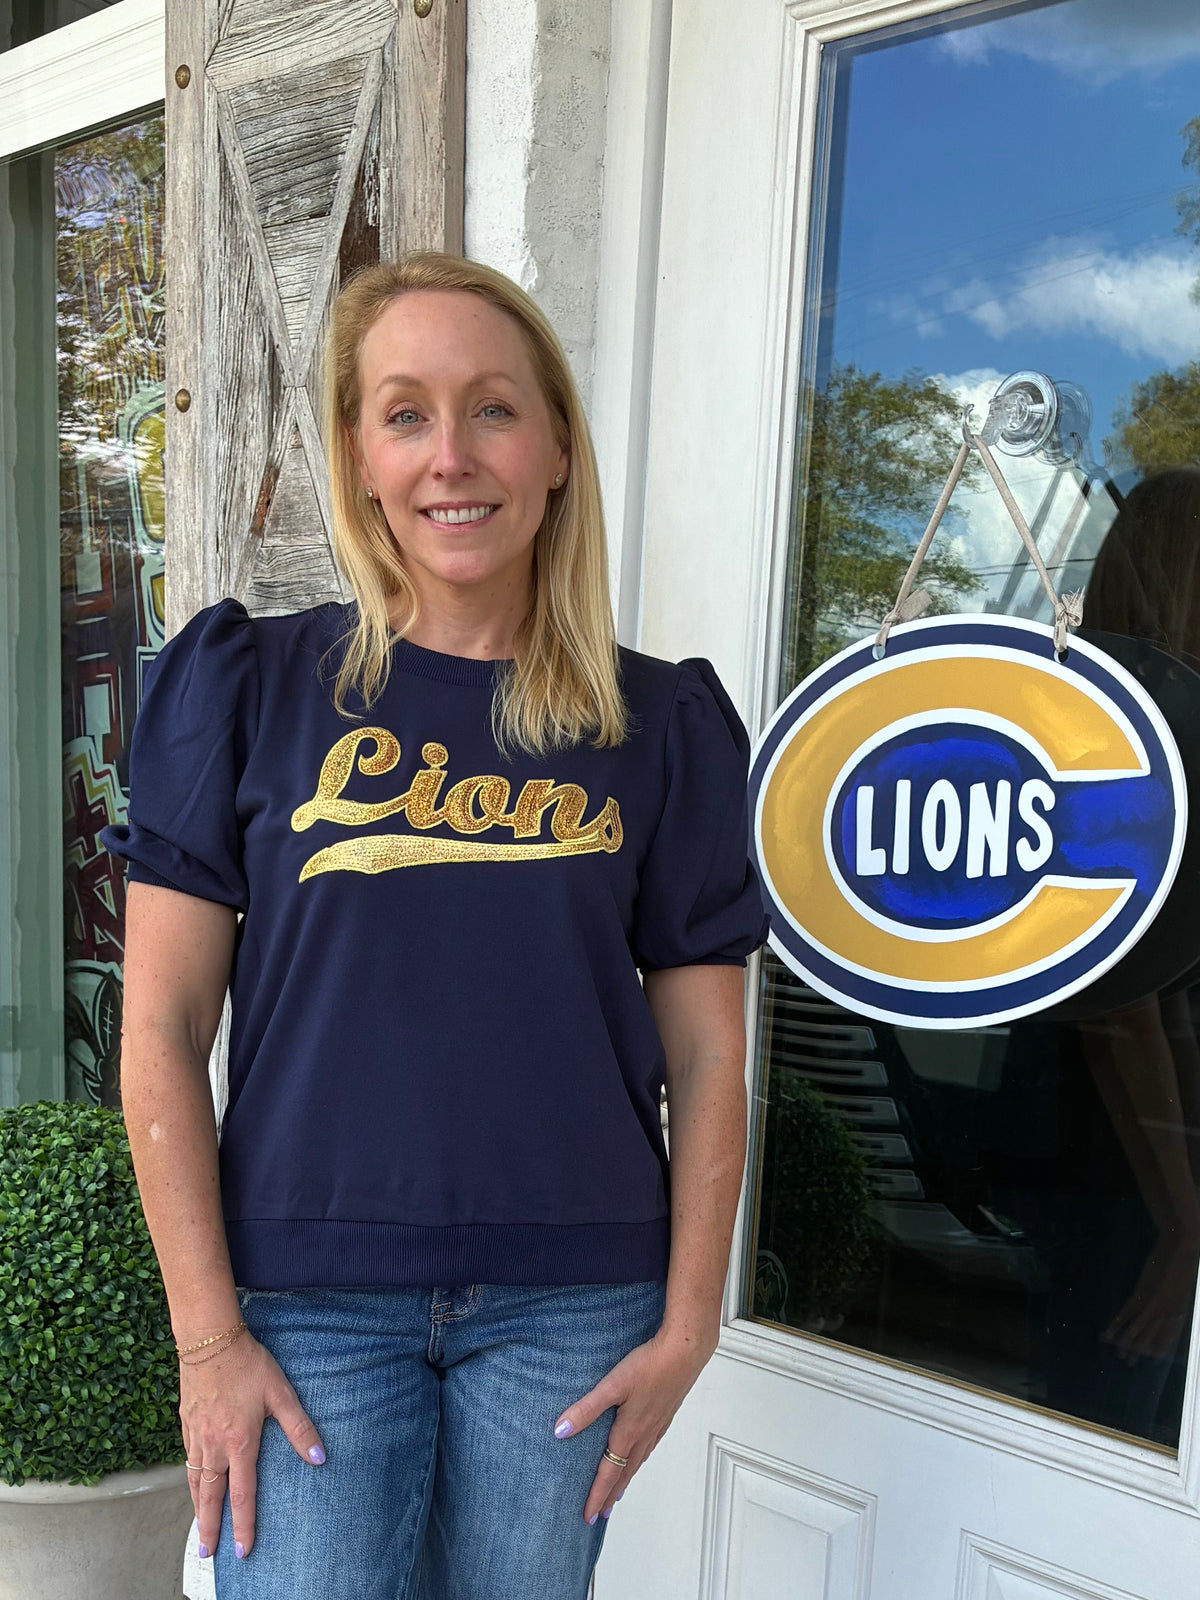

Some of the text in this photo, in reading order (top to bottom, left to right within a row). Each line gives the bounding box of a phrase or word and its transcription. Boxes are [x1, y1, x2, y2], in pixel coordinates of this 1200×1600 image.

[290, 726, 624, 854] Lions
[755, 643, 1151, 993] C
[856, 778, 1056, 880] LIONS
